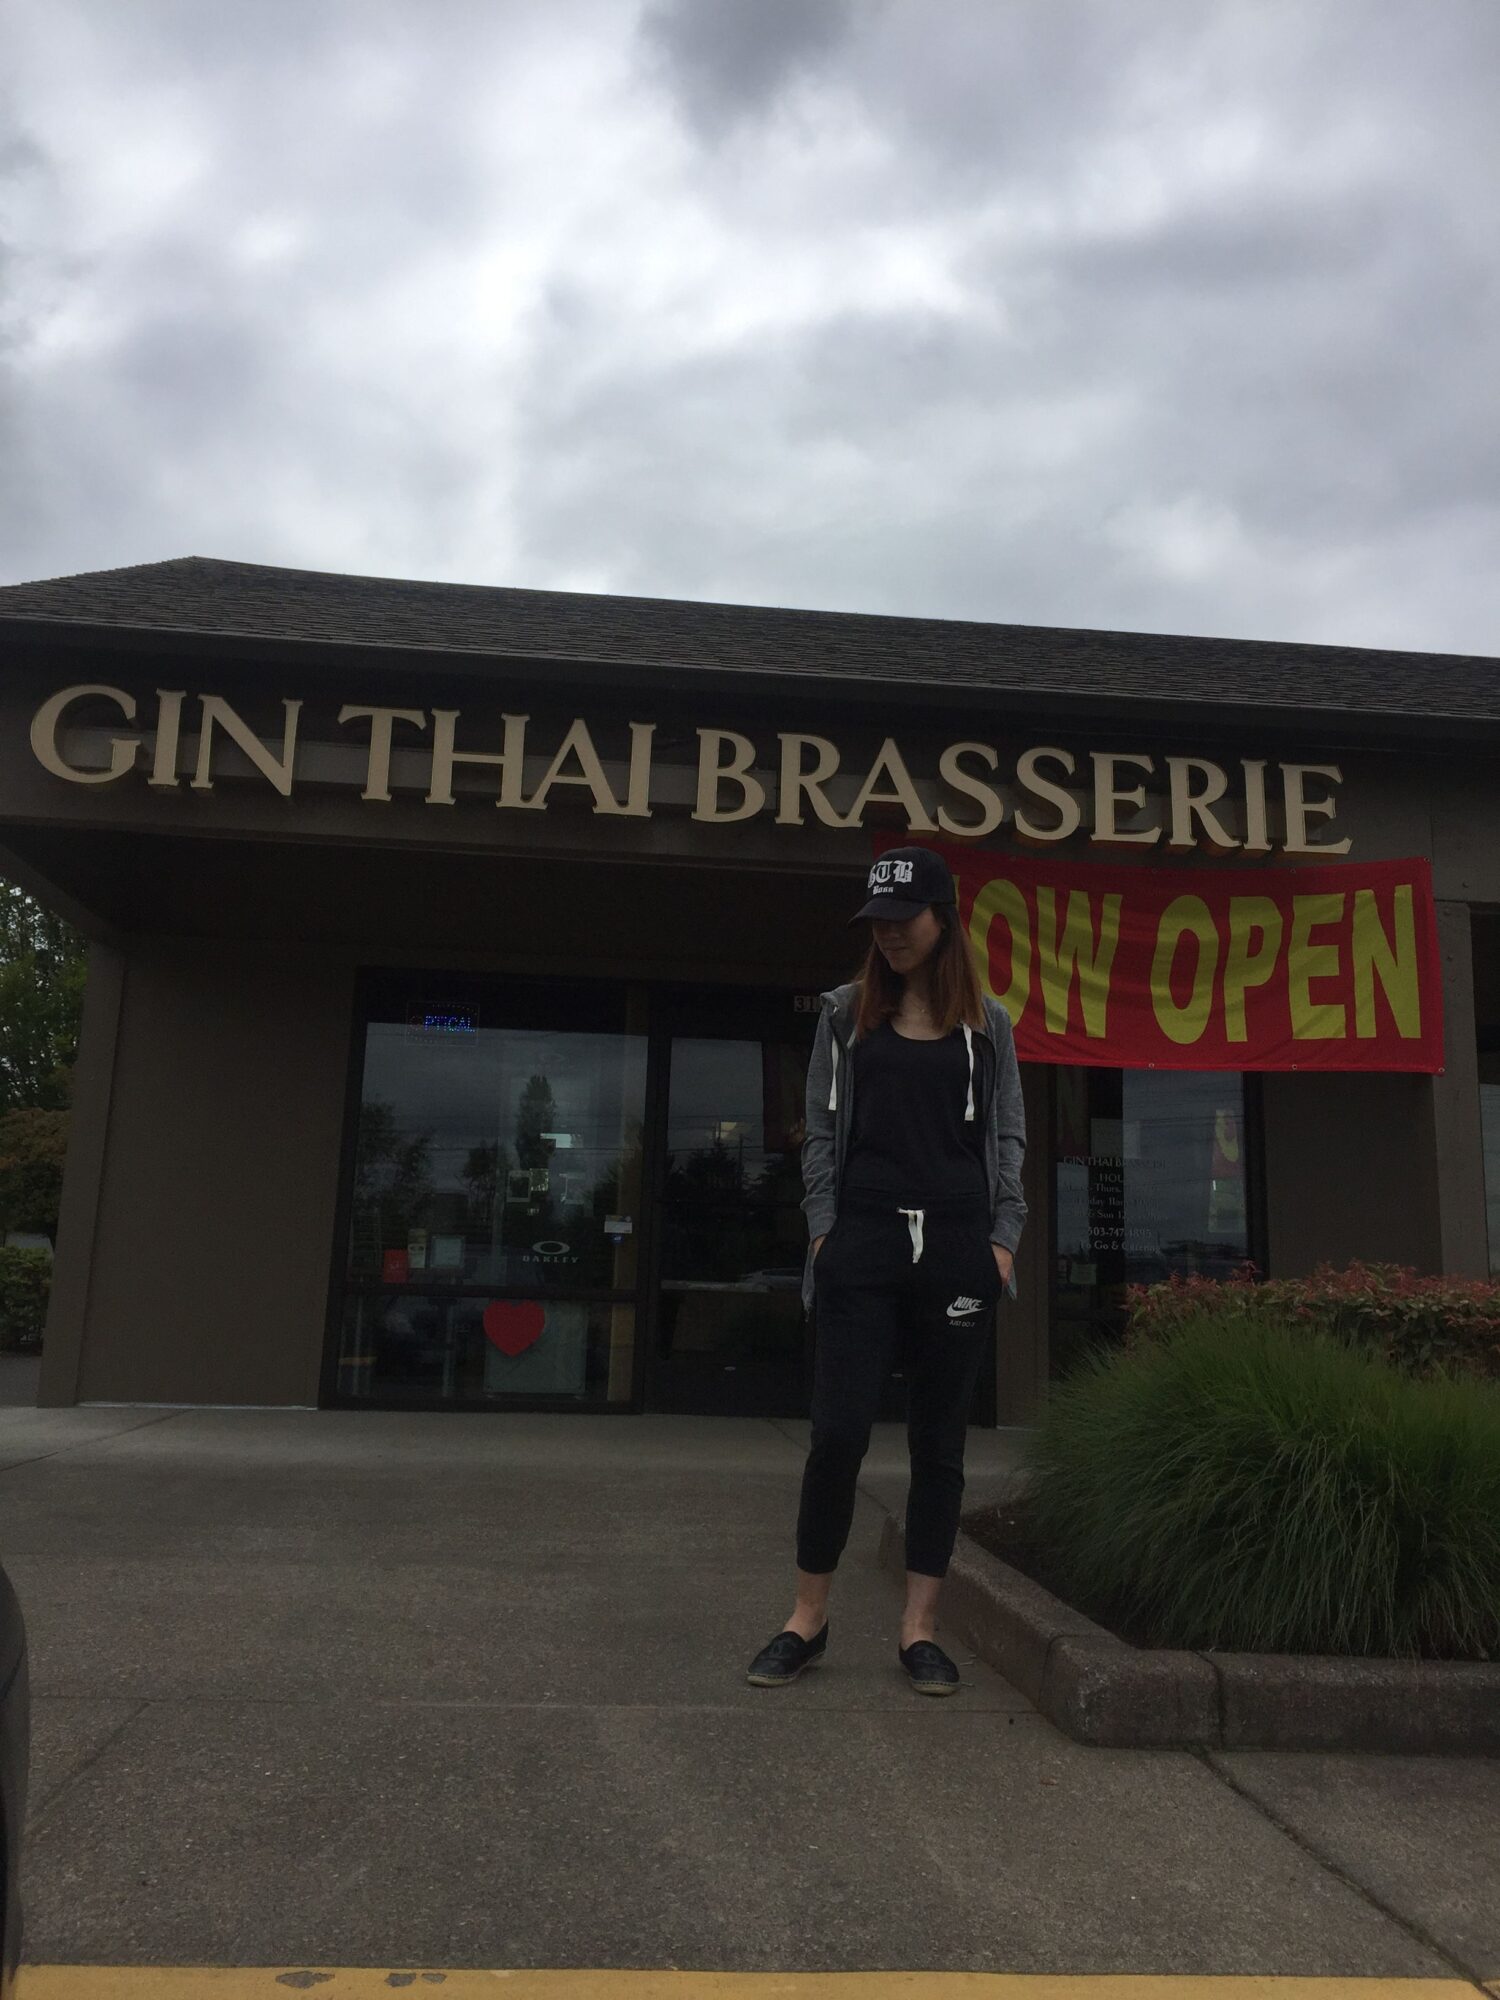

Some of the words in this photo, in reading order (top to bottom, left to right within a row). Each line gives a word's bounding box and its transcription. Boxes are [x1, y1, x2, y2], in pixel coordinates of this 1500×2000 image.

[30, 684, 303, 797] GIN
[337, 704, 657, 818] THAI
[691, 728, 1354, 856] BRASSERIE
[953, 874, 1125, 1040] OW
[1150, 884, 1422, 1045] OPEN
[1094, 1240, 1110, 1251] Go
[951, 1296, 982, 1308] NIKE
